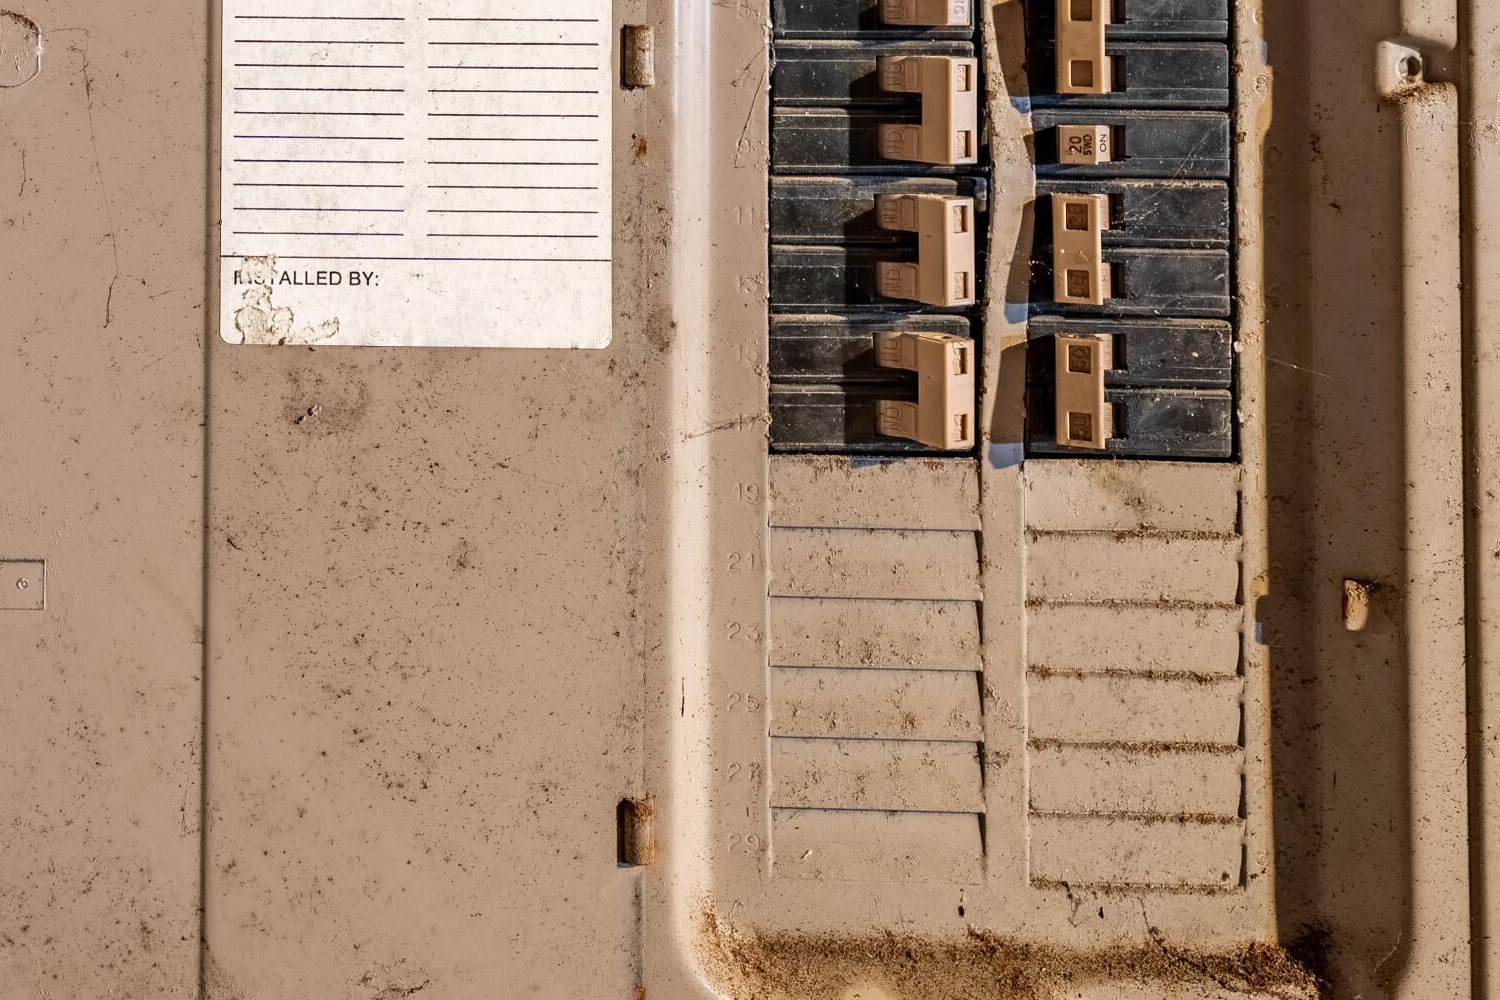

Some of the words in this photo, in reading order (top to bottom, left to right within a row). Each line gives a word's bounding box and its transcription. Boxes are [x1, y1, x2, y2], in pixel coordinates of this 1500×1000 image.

[1069, 136, 1082, 154] 20
[1083, 134, 1092, 155] SWD
[1100, 134, 1107, 152] ON
[348, 271, 378, 286] BY:
